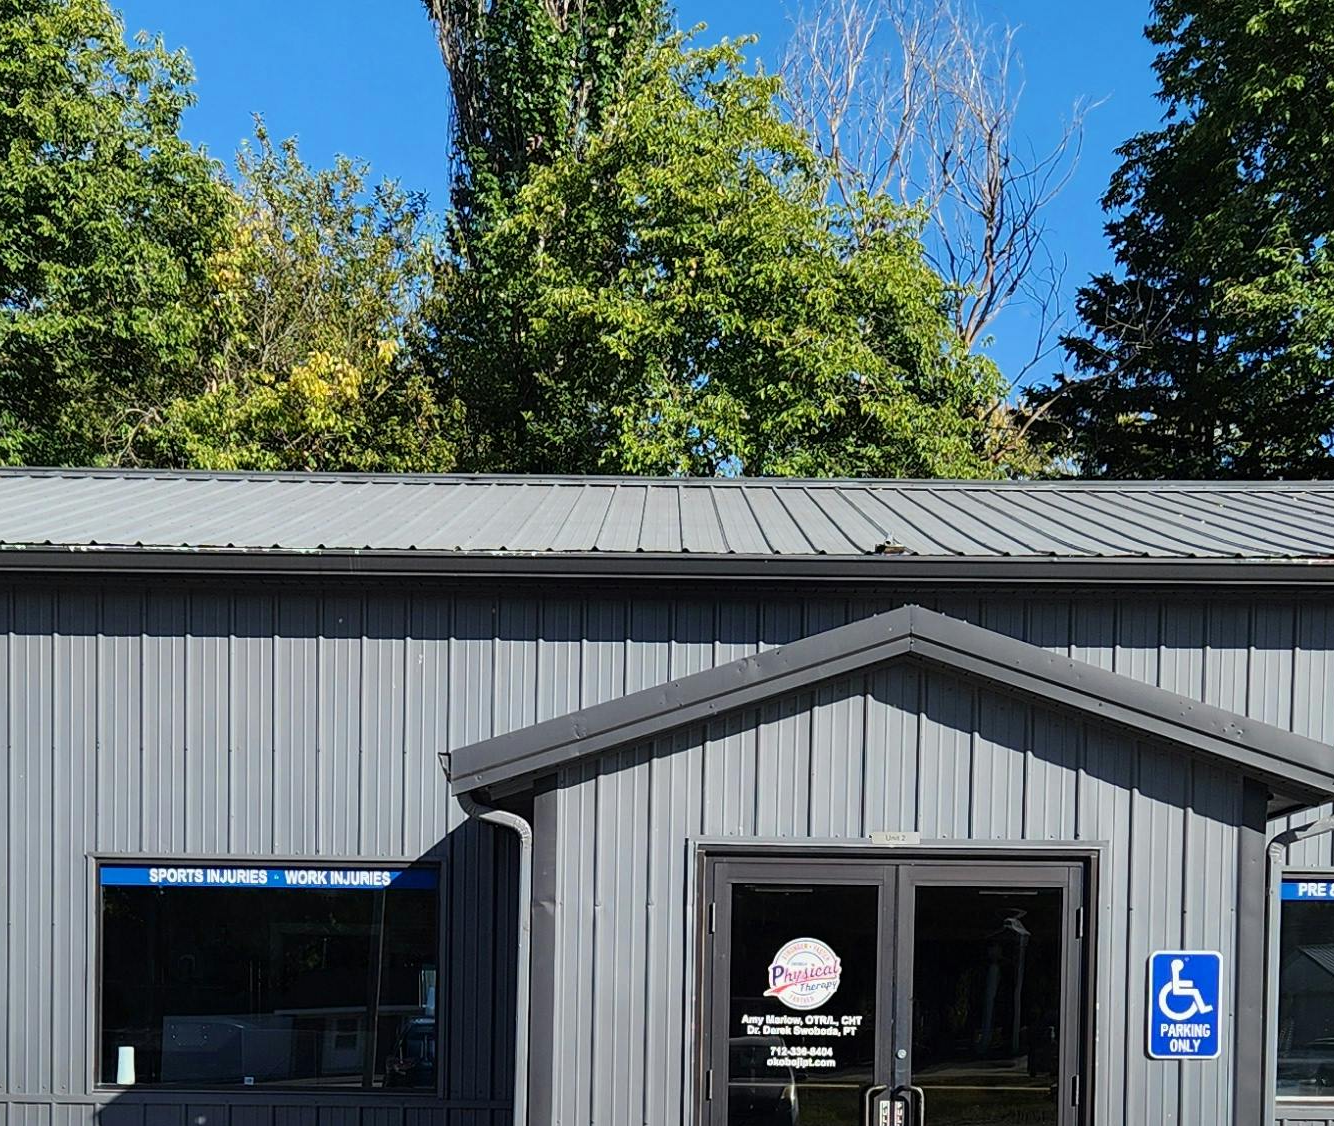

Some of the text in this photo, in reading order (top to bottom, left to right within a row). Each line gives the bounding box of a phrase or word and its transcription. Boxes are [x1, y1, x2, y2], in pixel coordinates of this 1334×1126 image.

[149, 868, 391, 886] SPORTS INJURIES WORK INJURIES
[1298, 883, 1327, 896] PRE
[772, 960, 838, 986] Physical
[800, 980, 838, 992] Therapy
[741, 1014, 765, 1026] Amy
[841, 1015, 863, 1026] CHT
[747, 1025, 761, 1035] Dr.
[763, 1025, 792, 1035] Derek
[843, 1026, 857, 1036] PT
[1160, 1023, 1211, 1038] PARKING
[1169, 1038, 1201, 1053] ONLY
